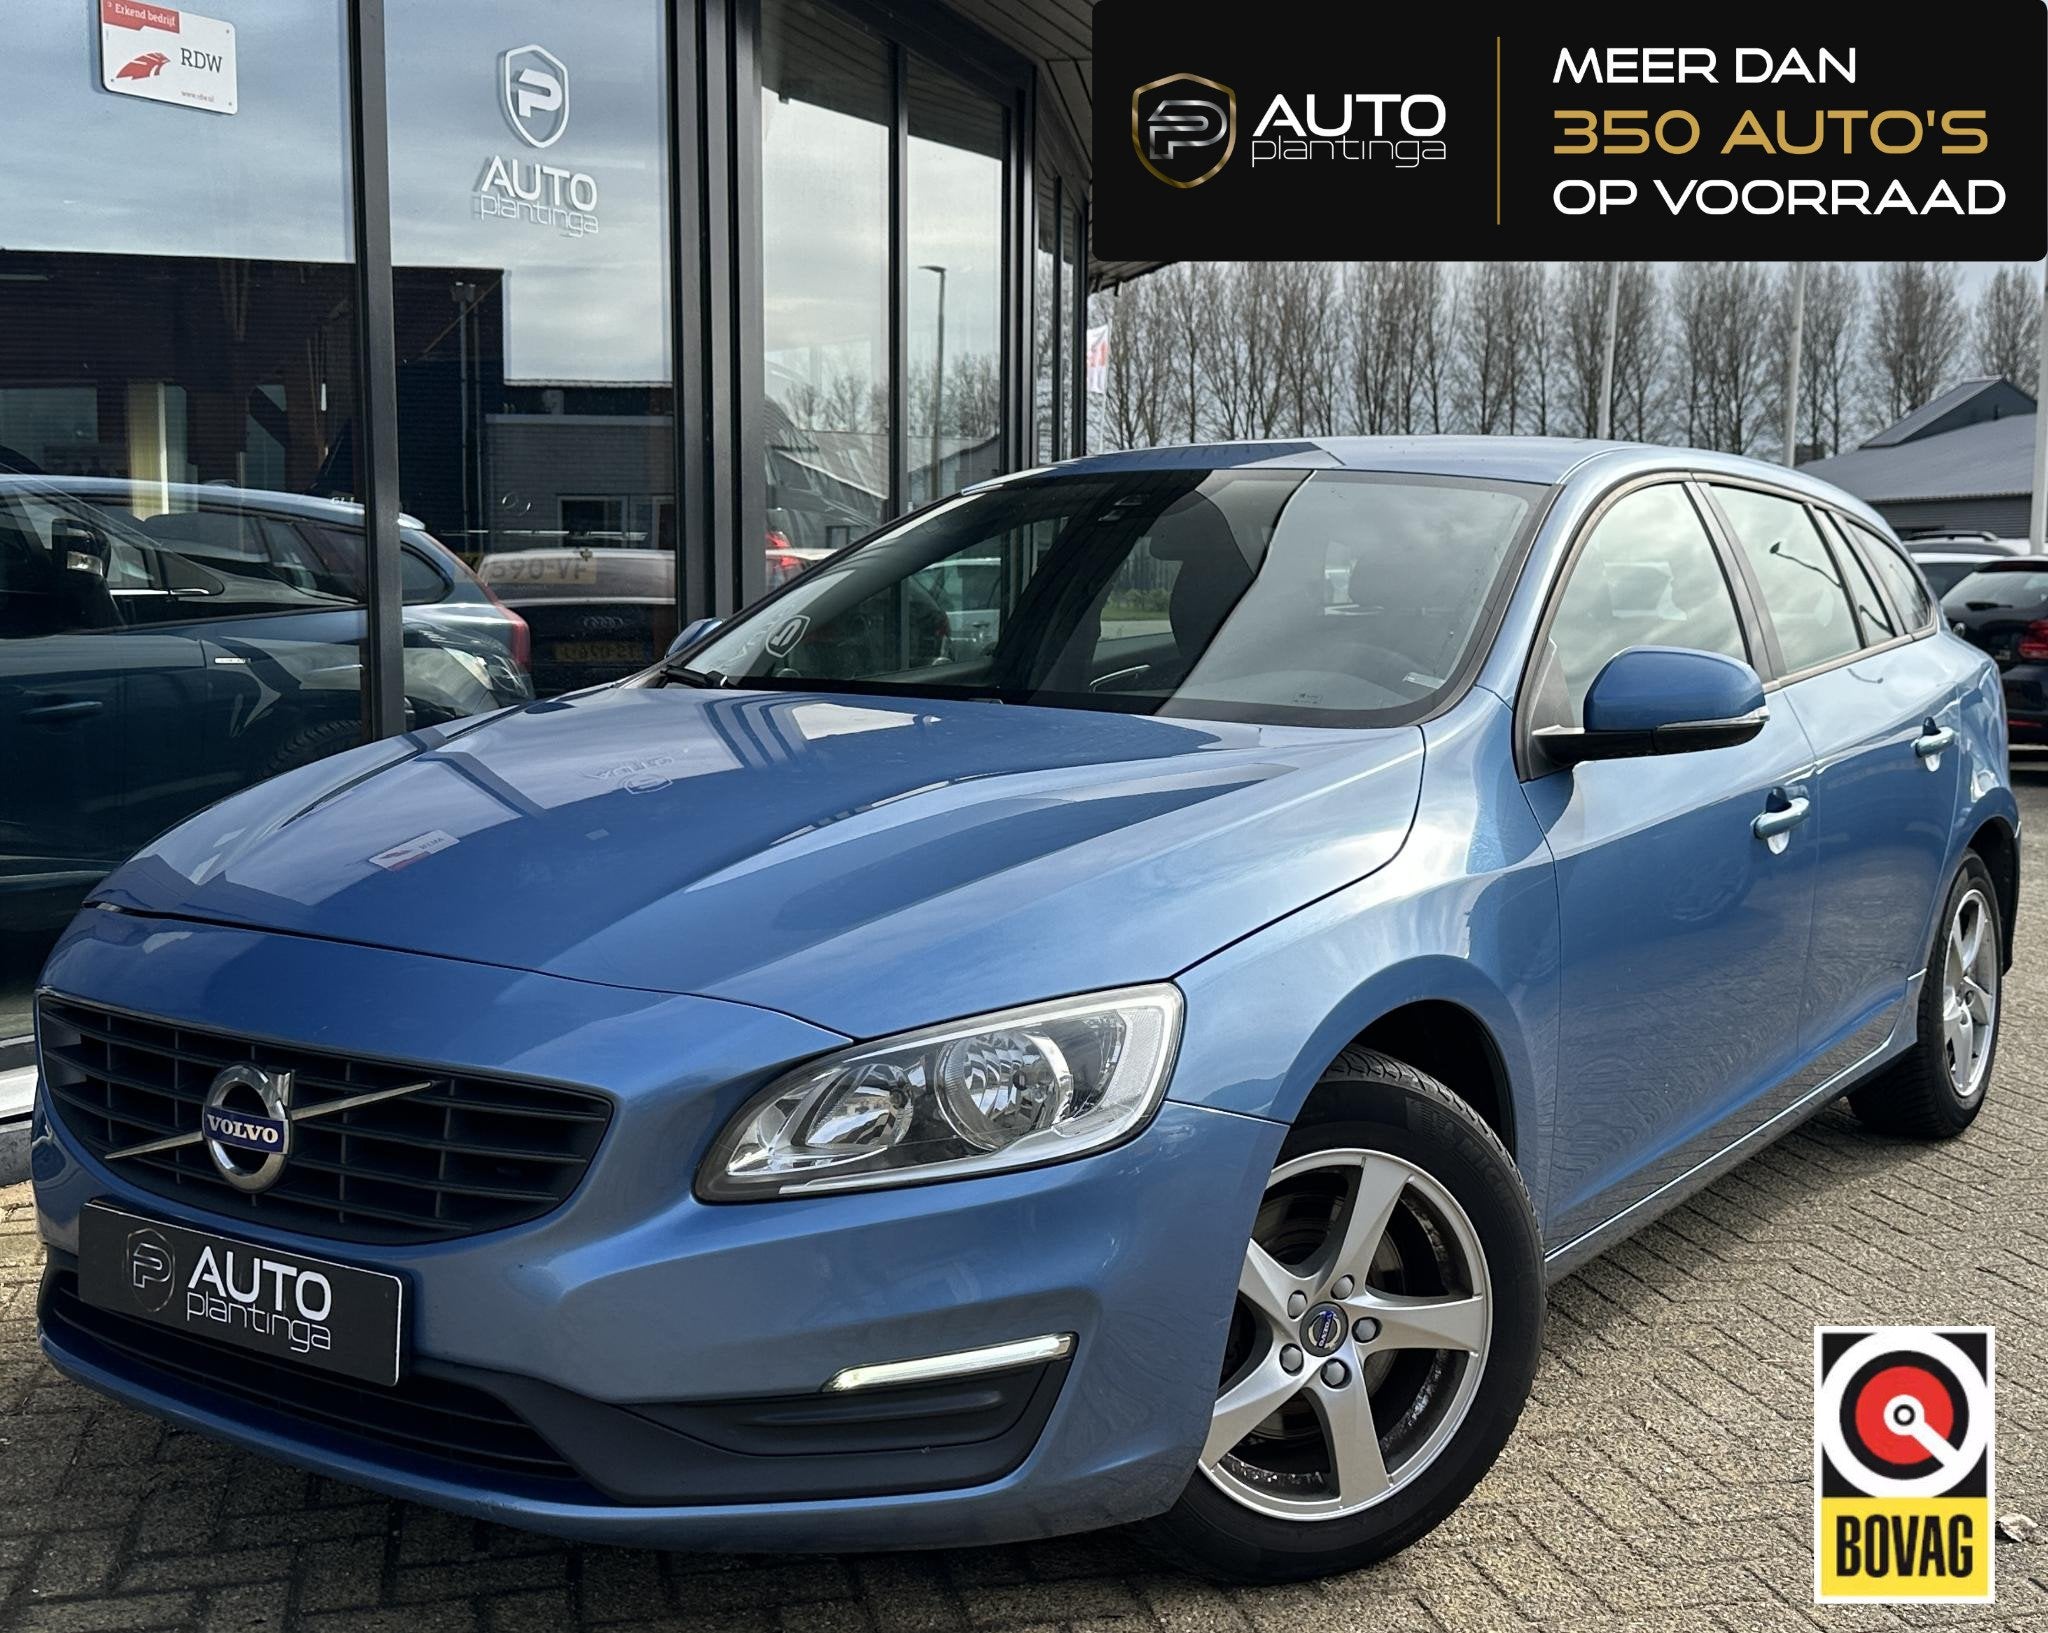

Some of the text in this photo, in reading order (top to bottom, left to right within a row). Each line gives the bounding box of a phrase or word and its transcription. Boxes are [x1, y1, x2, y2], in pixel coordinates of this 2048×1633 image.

[114, 3, 176, 28] Erkend bedrijf
[180, 47, 222, 73] RDW
[481, 155, 598, 212] AUTO
[480, 192, 599, 239] plantinga
[206, 1113, 279, 1144] VOLVO
[187, 1245, 332, 1322] AUTO
[187, 1290, 331, 1354] plantinga
